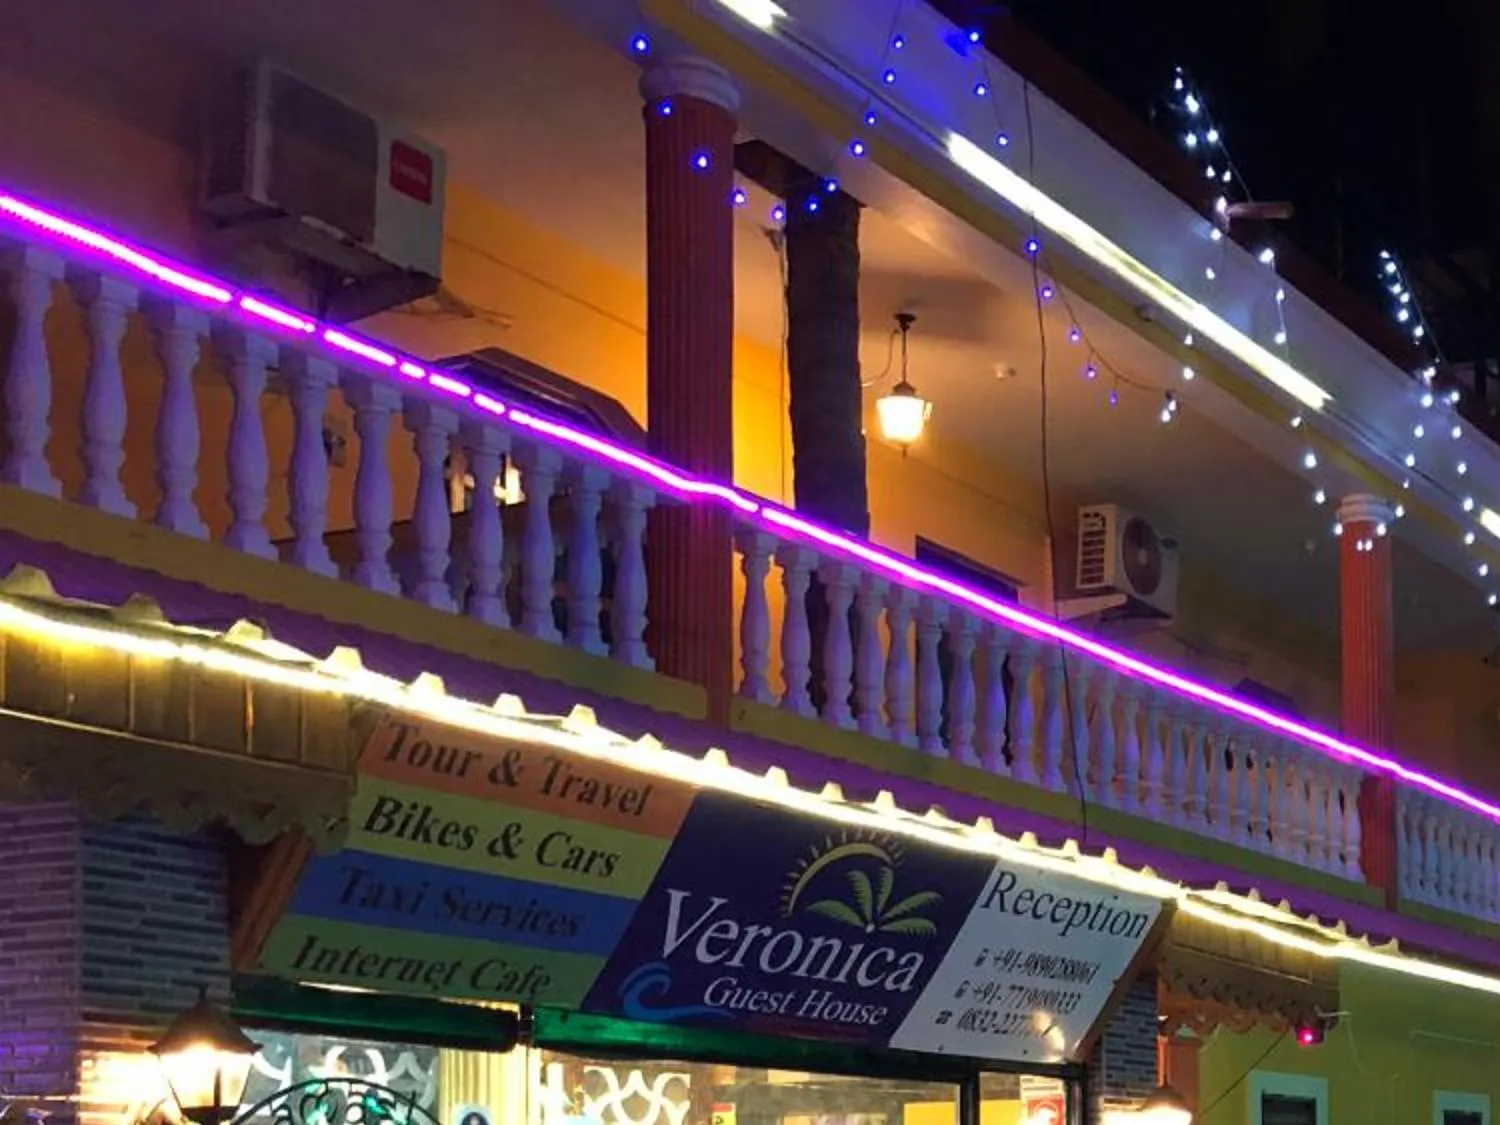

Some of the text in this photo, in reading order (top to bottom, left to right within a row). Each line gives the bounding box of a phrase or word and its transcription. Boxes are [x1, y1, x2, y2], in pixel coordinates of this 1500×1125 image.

[383, 717, 655, 817] Tour & Travel
[363, 795, 623, 879] Bikes & Cars
[337, 867, 585, 938] Taxi Services
[982, 870, 1150, 940] Reception
[293, 934, 553, 998] Internet Cafe
[663, 889, 925, 994] Veronica
[703, 976, 888, 1027] Guest House
